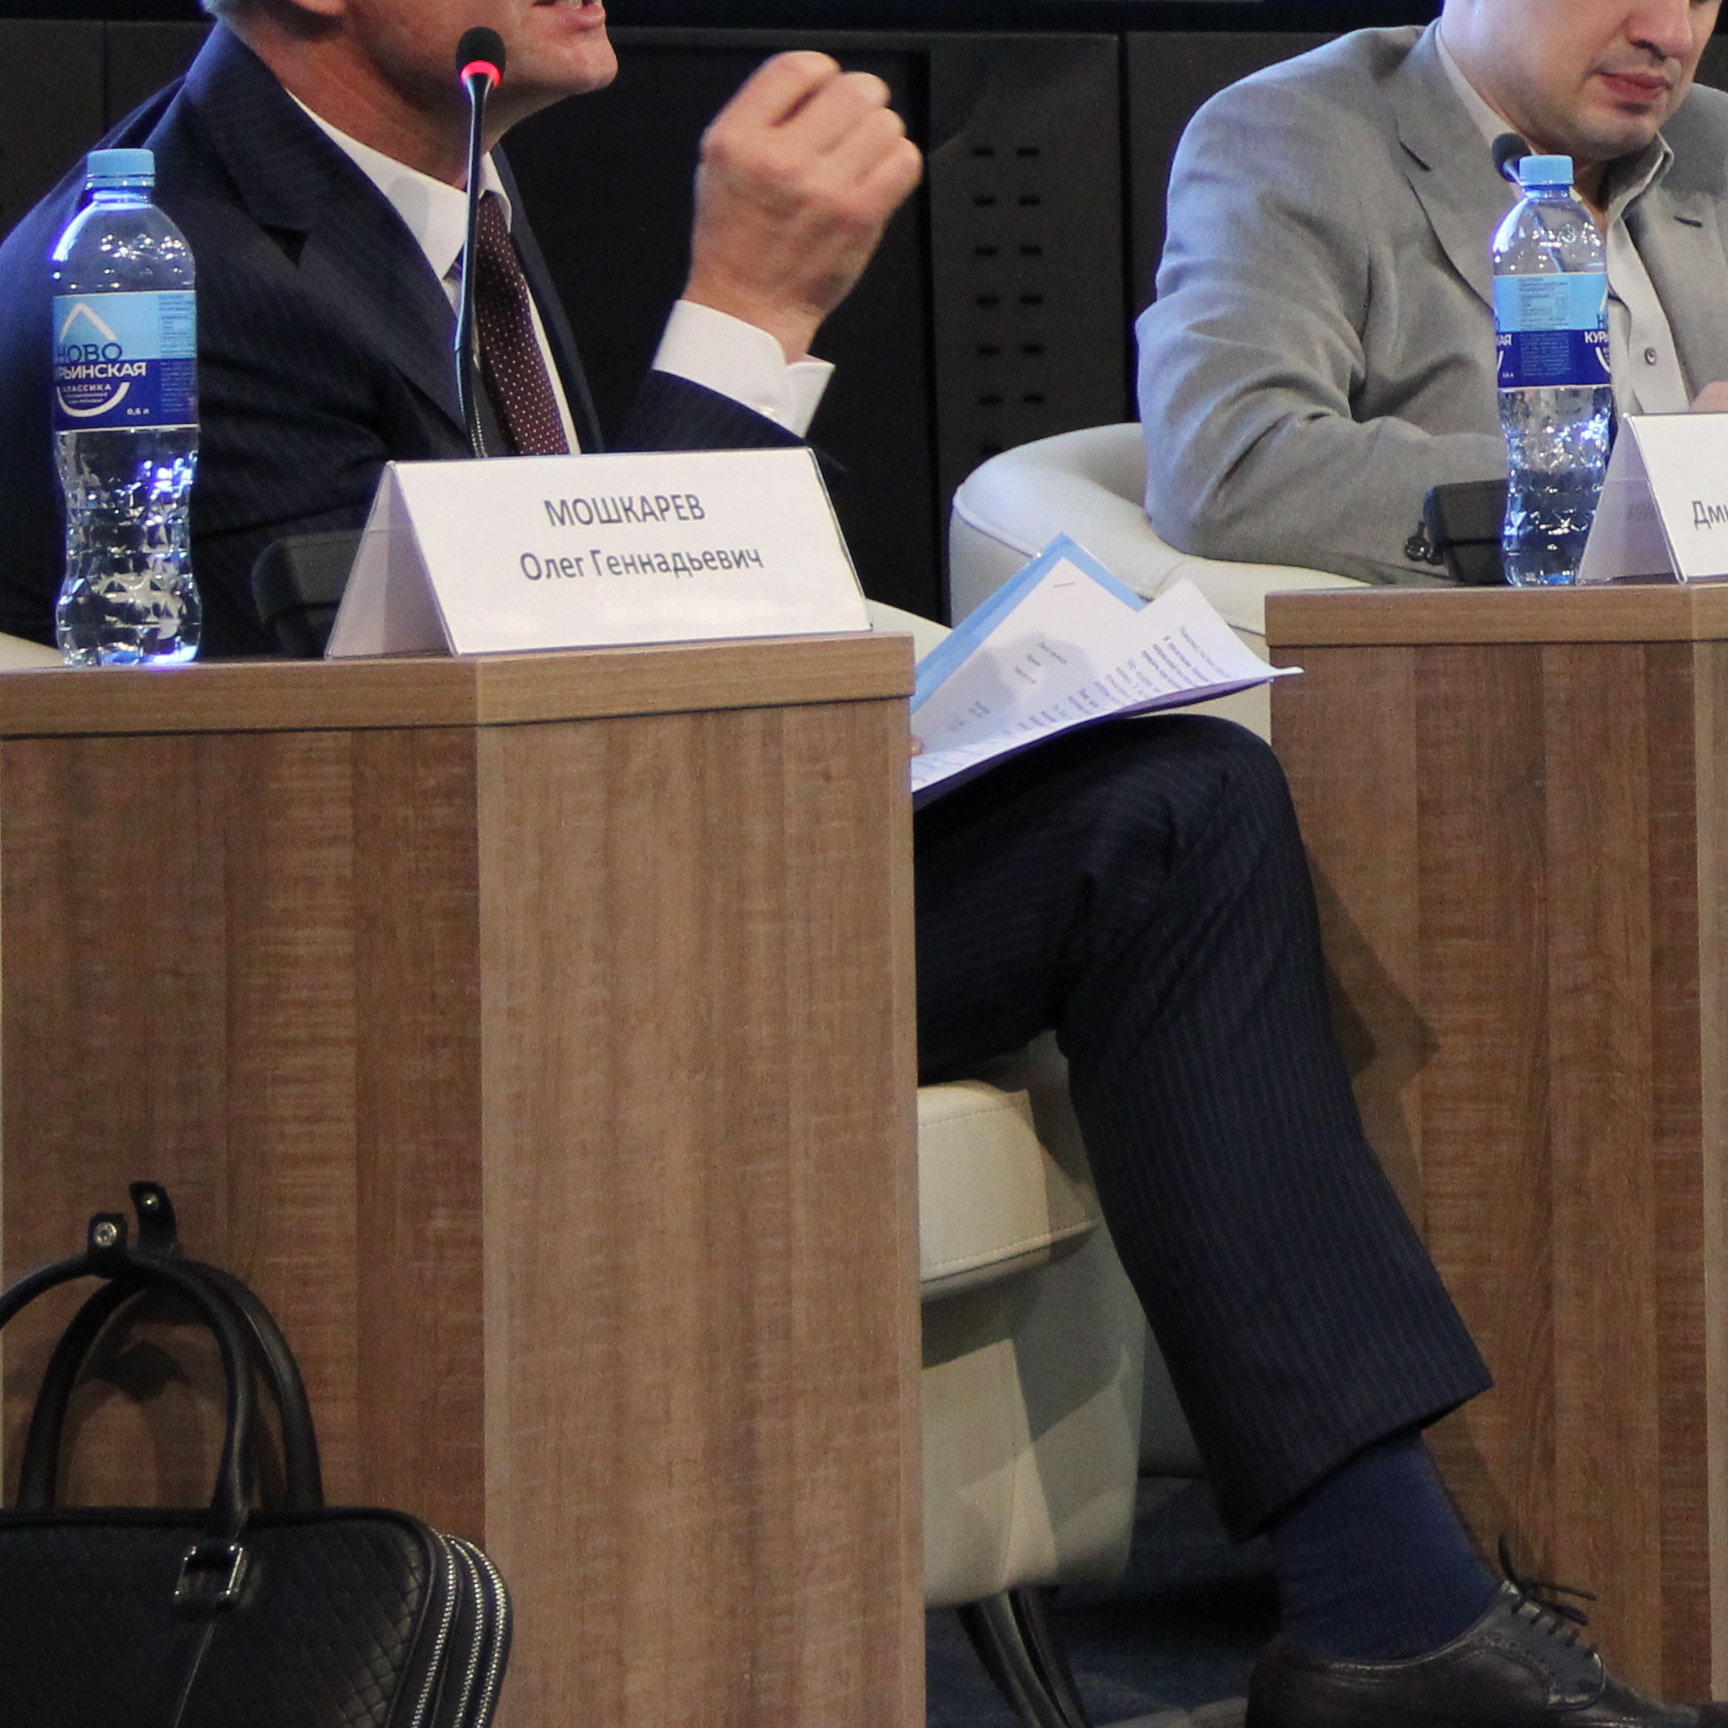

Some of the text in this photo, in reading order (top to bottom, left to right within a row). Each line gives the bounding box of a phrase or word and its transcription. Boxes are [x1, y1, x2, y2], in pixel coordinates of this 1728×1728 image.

[543, 493, 706, 527] МОШКАРЕВ
[519, 547, 765, 581] Олег Геннадьевич
